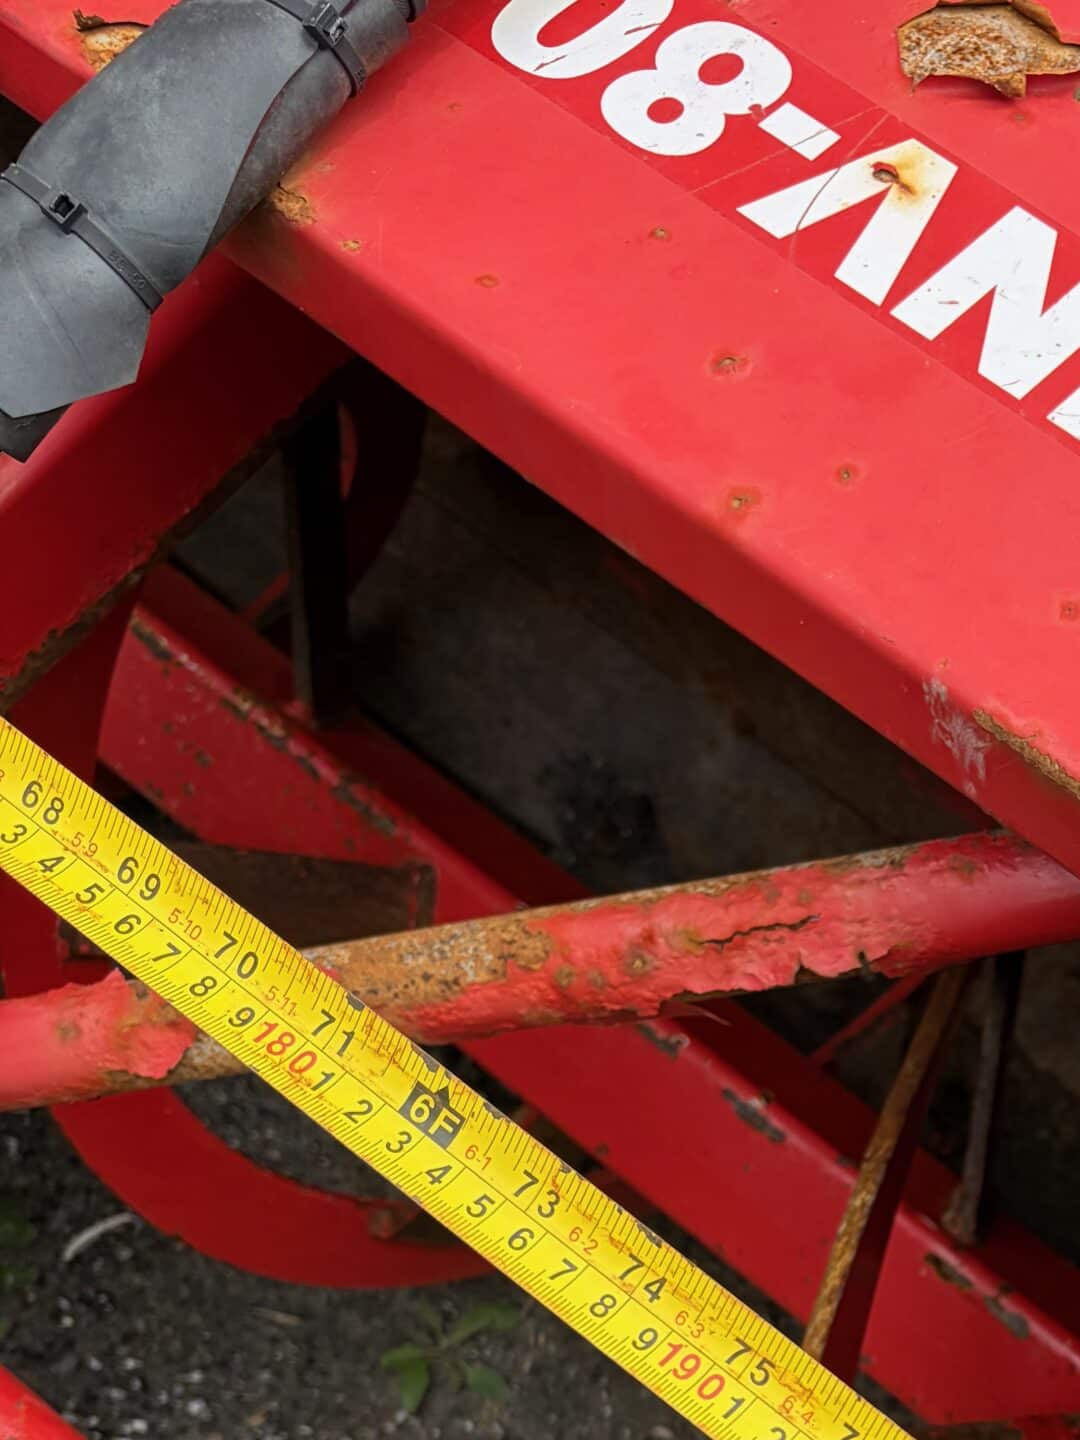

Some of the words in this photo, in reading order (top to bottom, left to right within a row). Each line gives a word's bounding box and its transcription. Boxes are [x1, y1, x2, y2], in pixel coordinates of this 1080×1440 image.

[0, 823, 28, 845] 3
[36, 855, 66, 875] 4
[74, 882, 106, 911] 5
[113, 913, 143, 942] 6
[151, 941, 183, 973] 7
[188, 975, 218, 1004] 8
[227, 1006, 256, 1035] 9
[307, 1071, 336, 1097] 1
[341, 1099, 374, 1128] 2
[384, 1130, 413, 1155] 3
[423, 1164, 454, 1187] 4
[465, 1193, 496, 1219] 5
[507, 1227, 535, 1252] 6
[548, 1257, 579, 1282] 7
[588, 1293, 618, 1319] 8
[630, 1327, 659, 1352] 9
[721, 1396, 747, 1421] 1
[21, 779, 66, 826] 68
[116, 856, 162, 902] 69
[213, 930, 260, 980] 70
[311, 1008, 356, 1059] 71
[404, 1093, 462, 1144] 6F
[513, 1169, 566, 1219] 73
[617, 1250, 669, 1304] 74
[725, 1335, 780, 1387] 75
